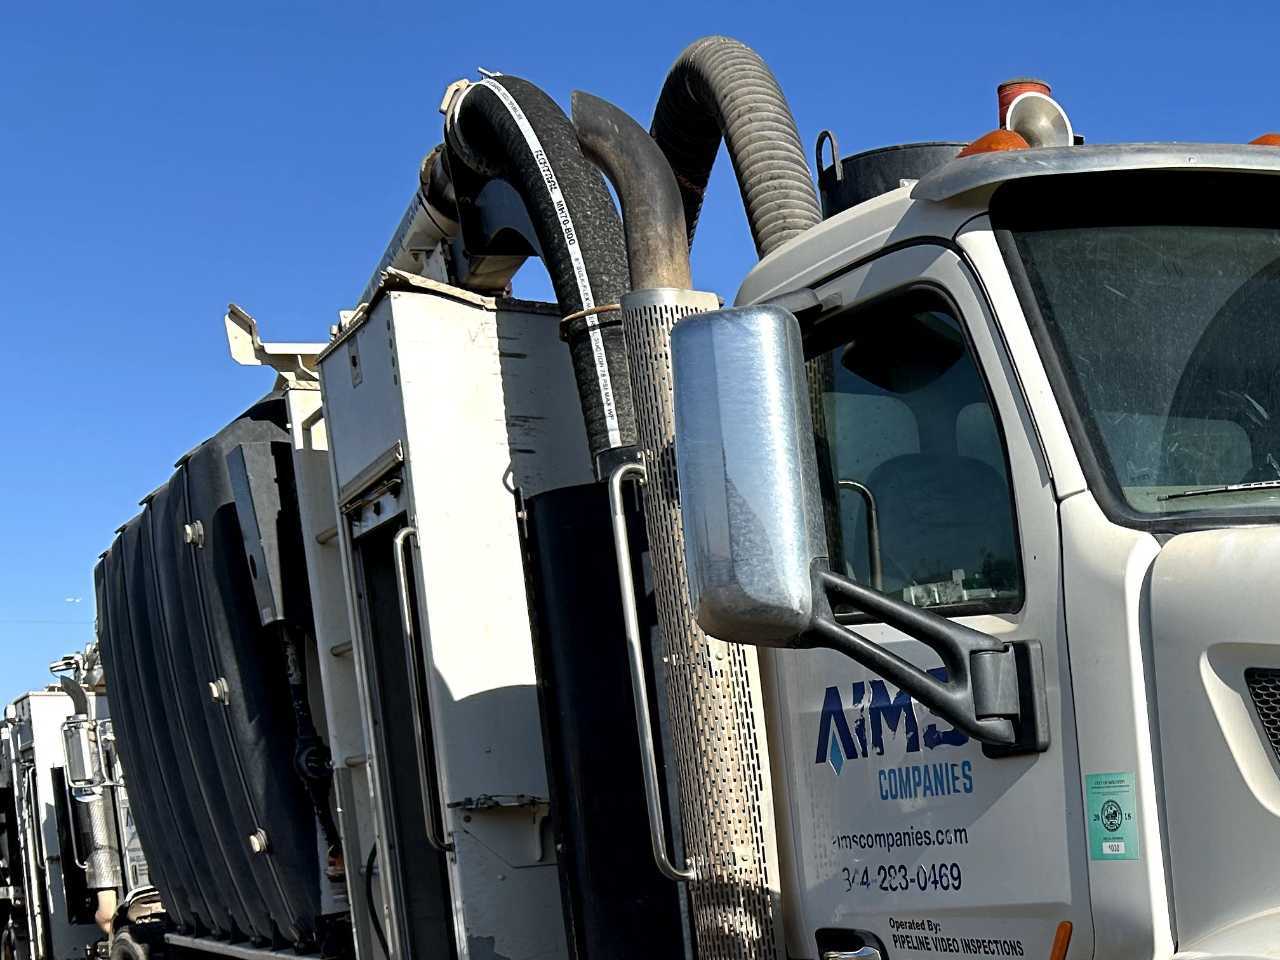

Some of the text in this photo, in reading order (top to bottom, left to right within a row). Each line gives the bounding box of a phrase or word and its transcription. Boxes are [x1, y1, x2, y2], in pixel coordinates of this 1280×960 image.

[878, 760, 973, 801] COMPANIES
[833, 826, 968, 852] imscompanies.com
[889, 917, 941, 934] Operated By:
[892, 934, 1024, 956] PIPELINE VIDEO INSPECTIONS
